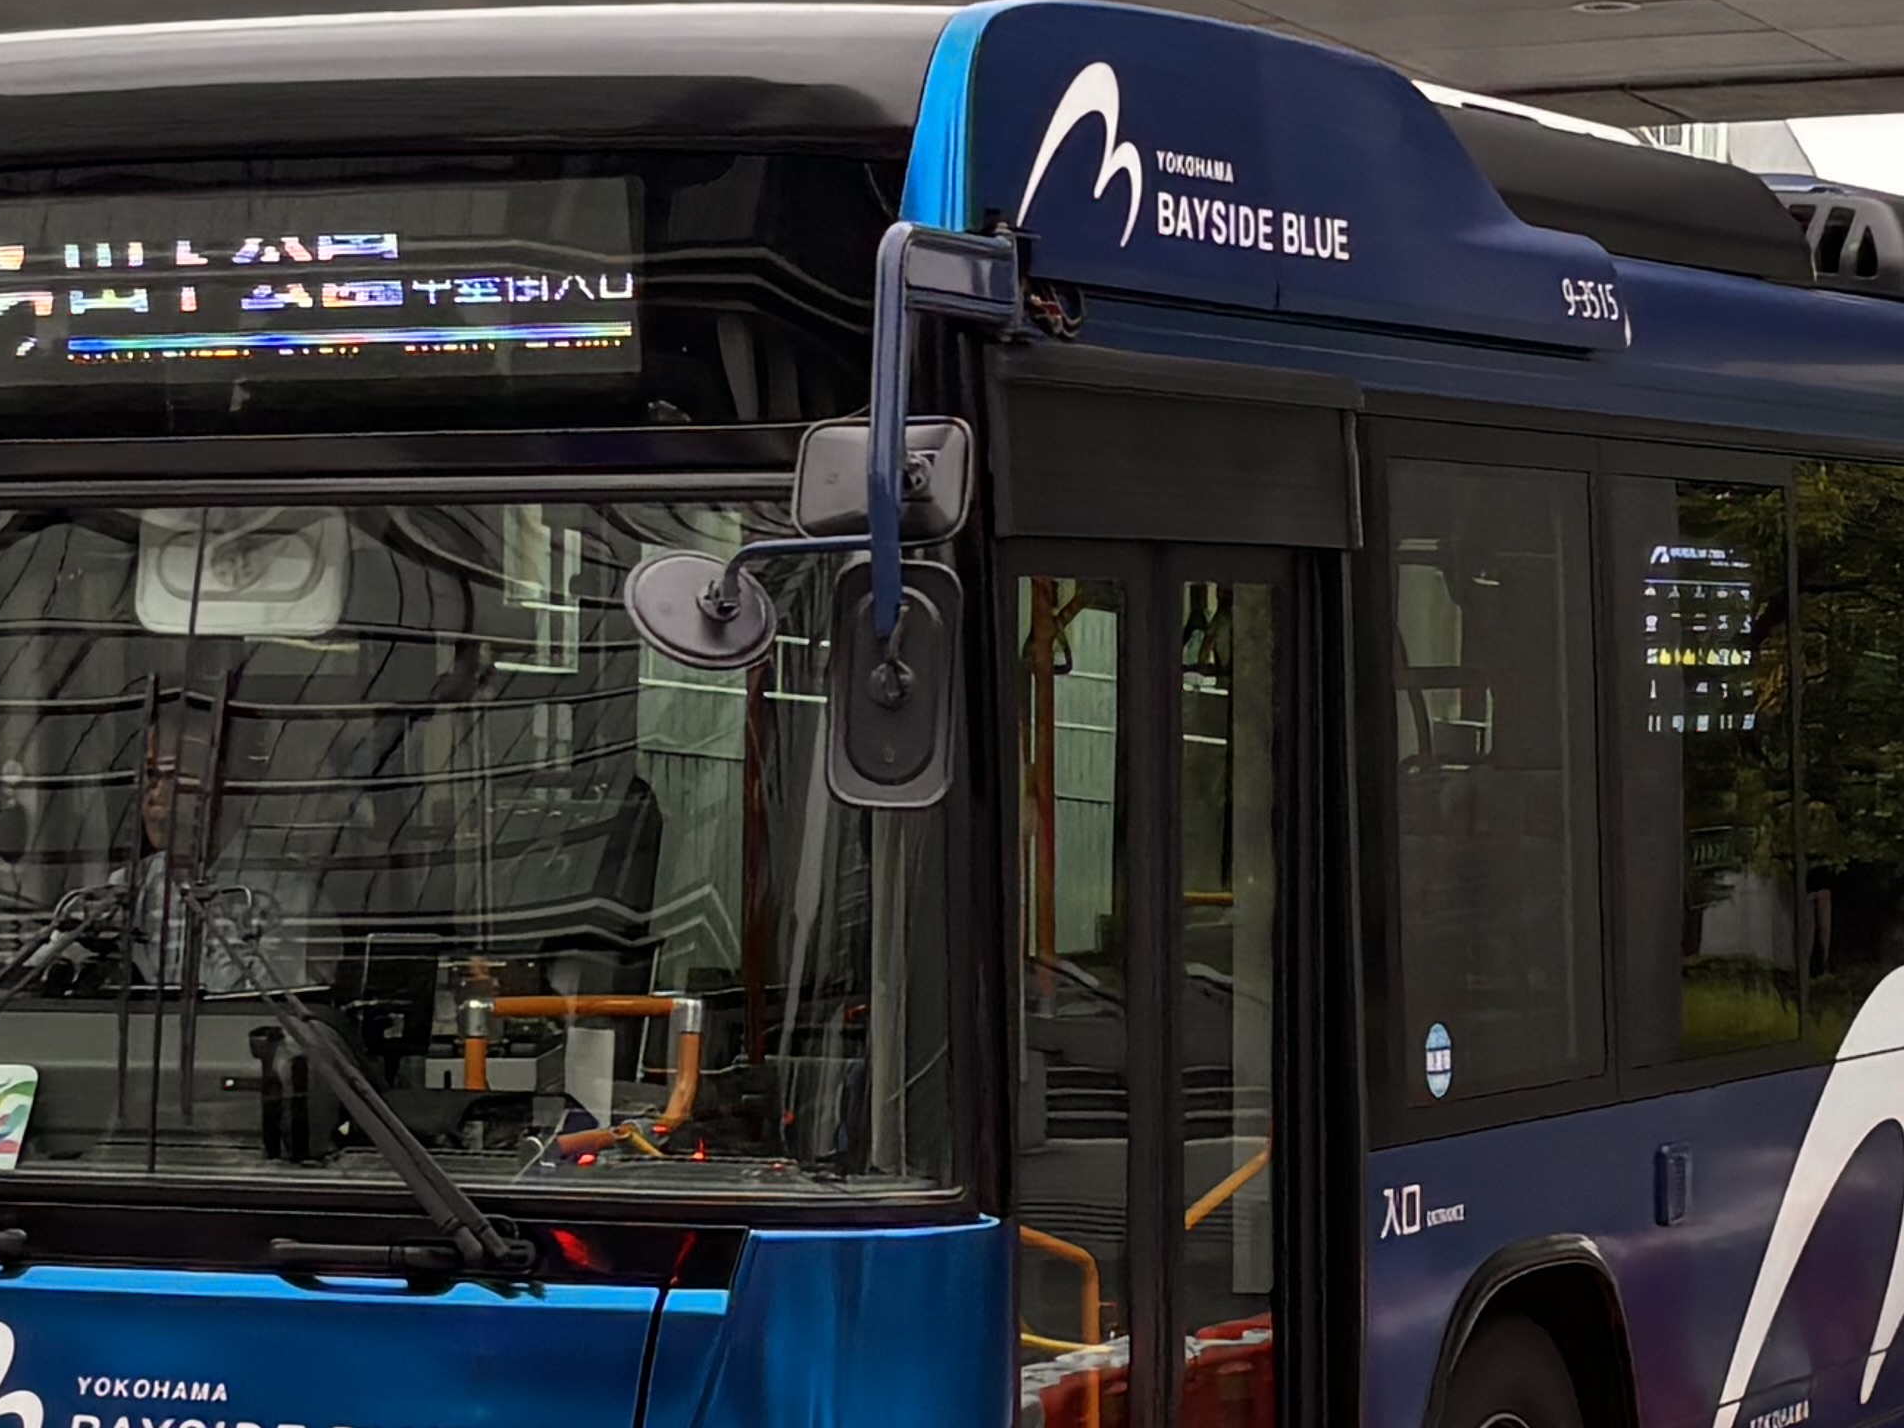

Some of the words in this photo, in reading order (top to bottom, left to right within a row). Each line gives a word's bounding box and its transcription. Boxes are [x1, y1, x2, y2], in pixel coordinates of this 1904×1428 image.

[1156, 150, 1234, 184] YOKOHAMA
[1157, 192, 1274, 253] BAYSIDE
[1282, 211, 1349, 262] BLUE
[1562, 277, 1618, 321] 9-3515
[1381, 1184, 1420, 1239] 入口
[77, 1377, 228, 1404] YOKOHAMA
